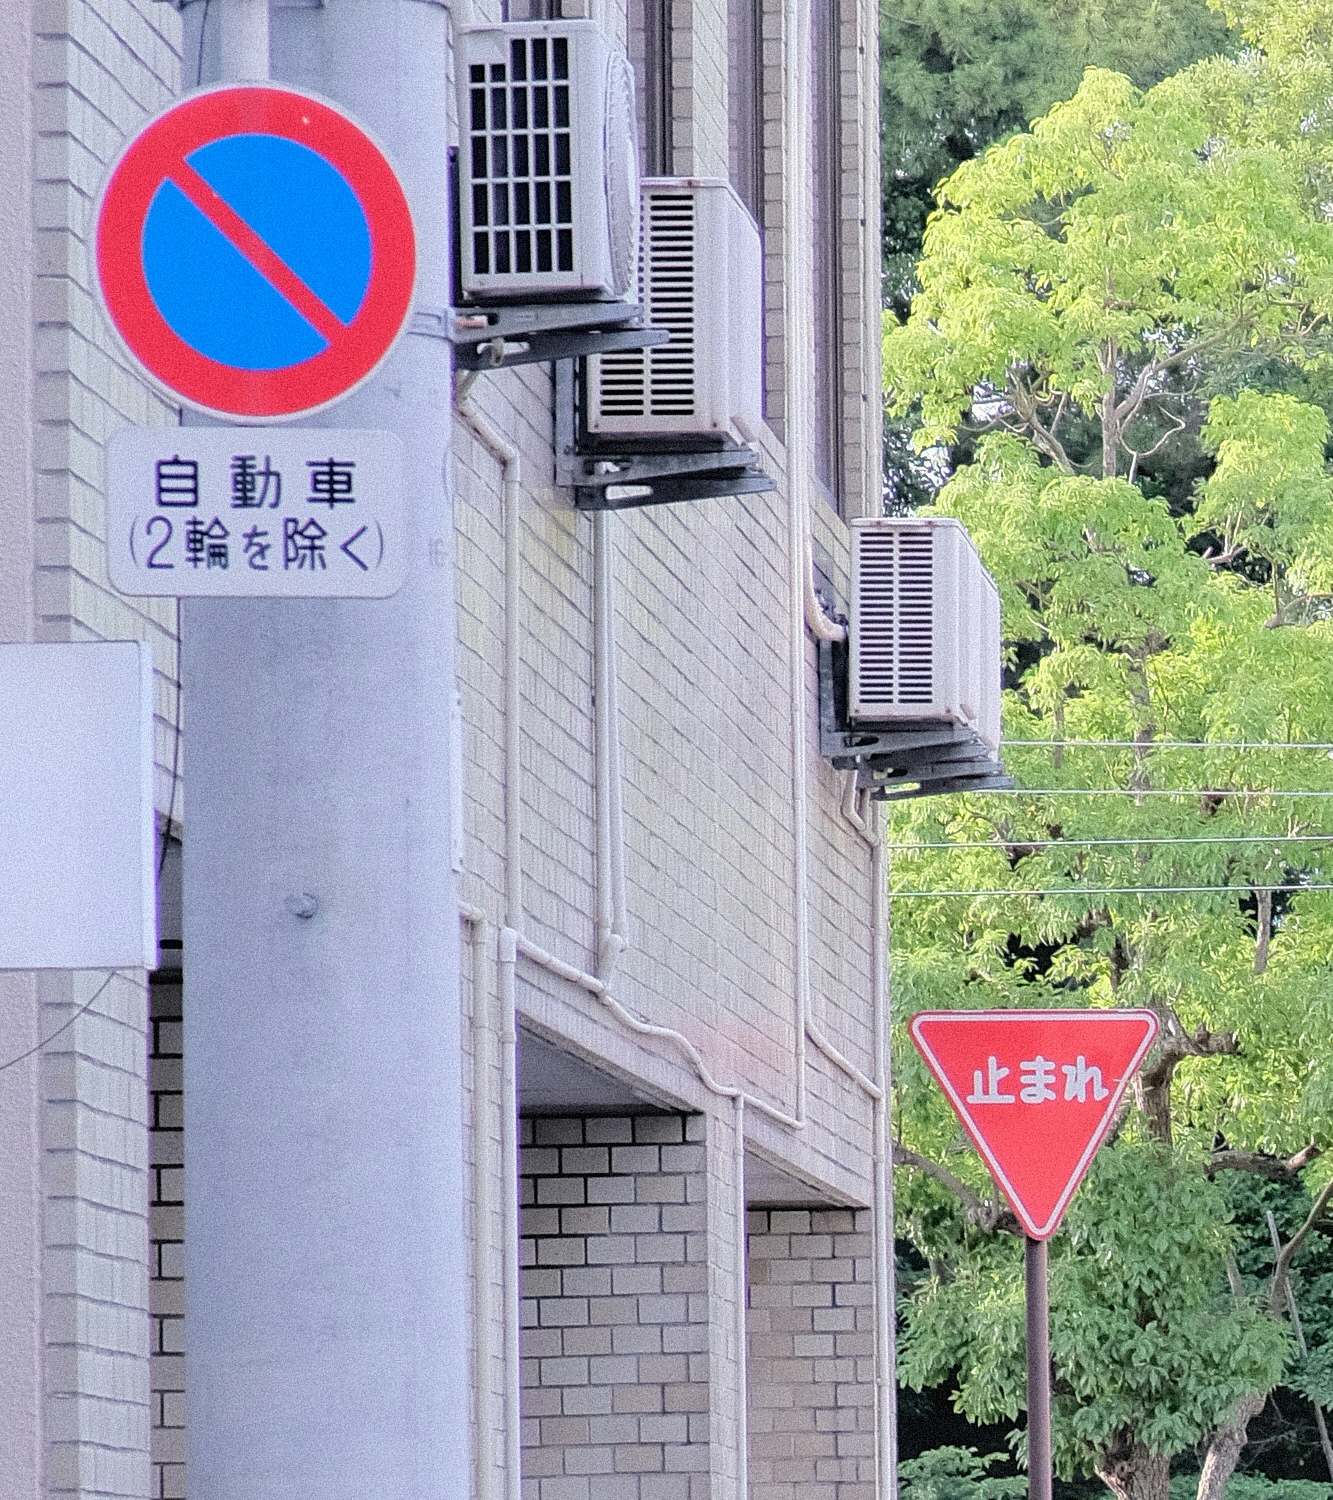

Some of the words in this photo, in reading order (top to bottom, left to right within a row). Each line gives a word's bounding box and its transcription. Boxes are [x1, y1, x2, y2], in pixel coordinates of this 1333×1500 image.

[155, 455, 356, 509] 自動車
[129, 514, 384, 571] (2輪を除く)
[966, 1055, 1109, 1104] 止まれ
